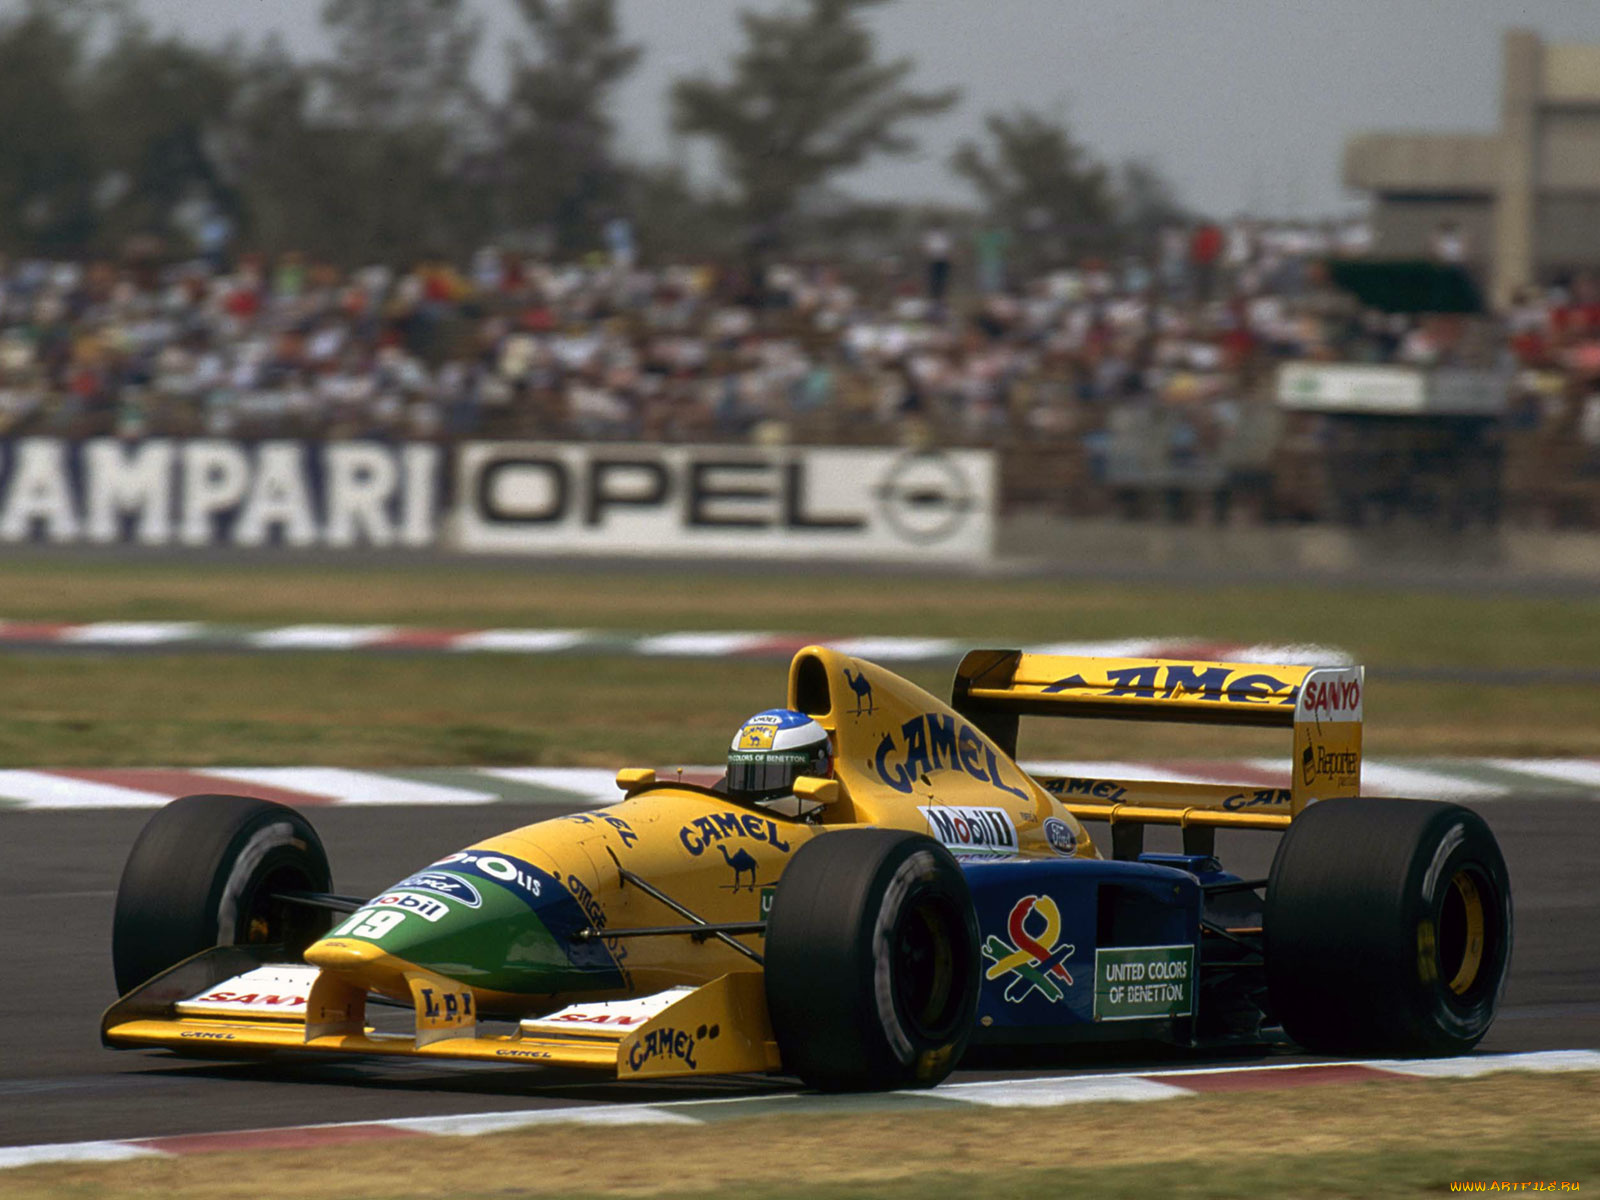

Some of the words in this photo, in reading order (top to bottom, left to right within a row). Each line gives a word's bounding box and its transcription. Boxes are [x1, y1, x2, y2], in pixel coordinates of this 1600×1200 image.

[0, 436, 440, 546] AMPARI
[478, 456, 867, 532] OPEL
[1304, 680, 1360, 711] SANYO
[875, 713, 1029, 801] CAMEL
[1046, 779, 1128, 804] AMEL
[1222, 788, 1292, 812] CAM
[680, 812, 790, 856] CAMEL
[927, 810, 996, 846] Mobil
[1051, 822, 1073, 849] Ford
[334, 909, 406, 940] 19
[1106, 963, 1145, 981] UNITED
[1148, 961, 1187, 979] COLORS
[198, 992, 308, 1006] SANY
[1109, 986, 1125, 1003] OF
[549, 1014, 652, 1025] SAN
[180, 1031, 236, 1039] CAMEL
[496, 1049, 552, 1058] CAMEL
[630, 1028, 697, 1070] CAMEL
